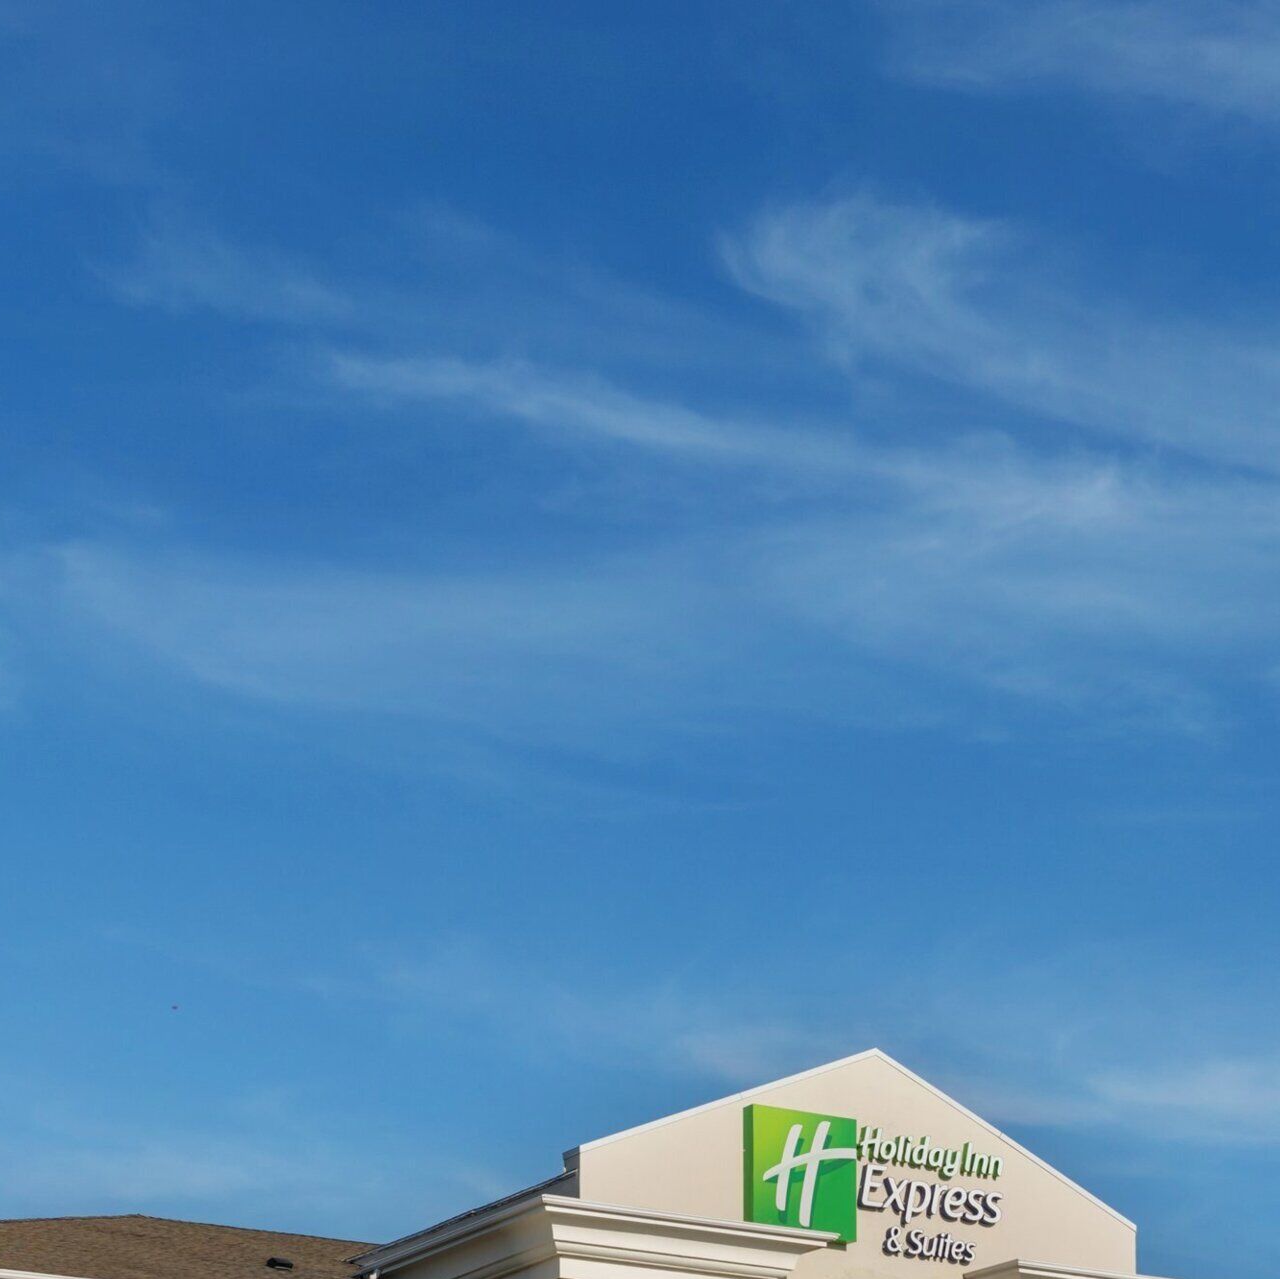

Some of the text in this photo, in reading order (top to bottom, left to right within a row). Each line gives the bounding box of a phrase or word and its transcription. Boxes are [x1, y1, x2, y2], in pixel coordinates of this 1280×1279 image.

[857, 1126, 1005, 1180] Holiday Inn
[858, 1164, 1004, 1226] Express
[883, 1226, 977, 1264] & Suites
